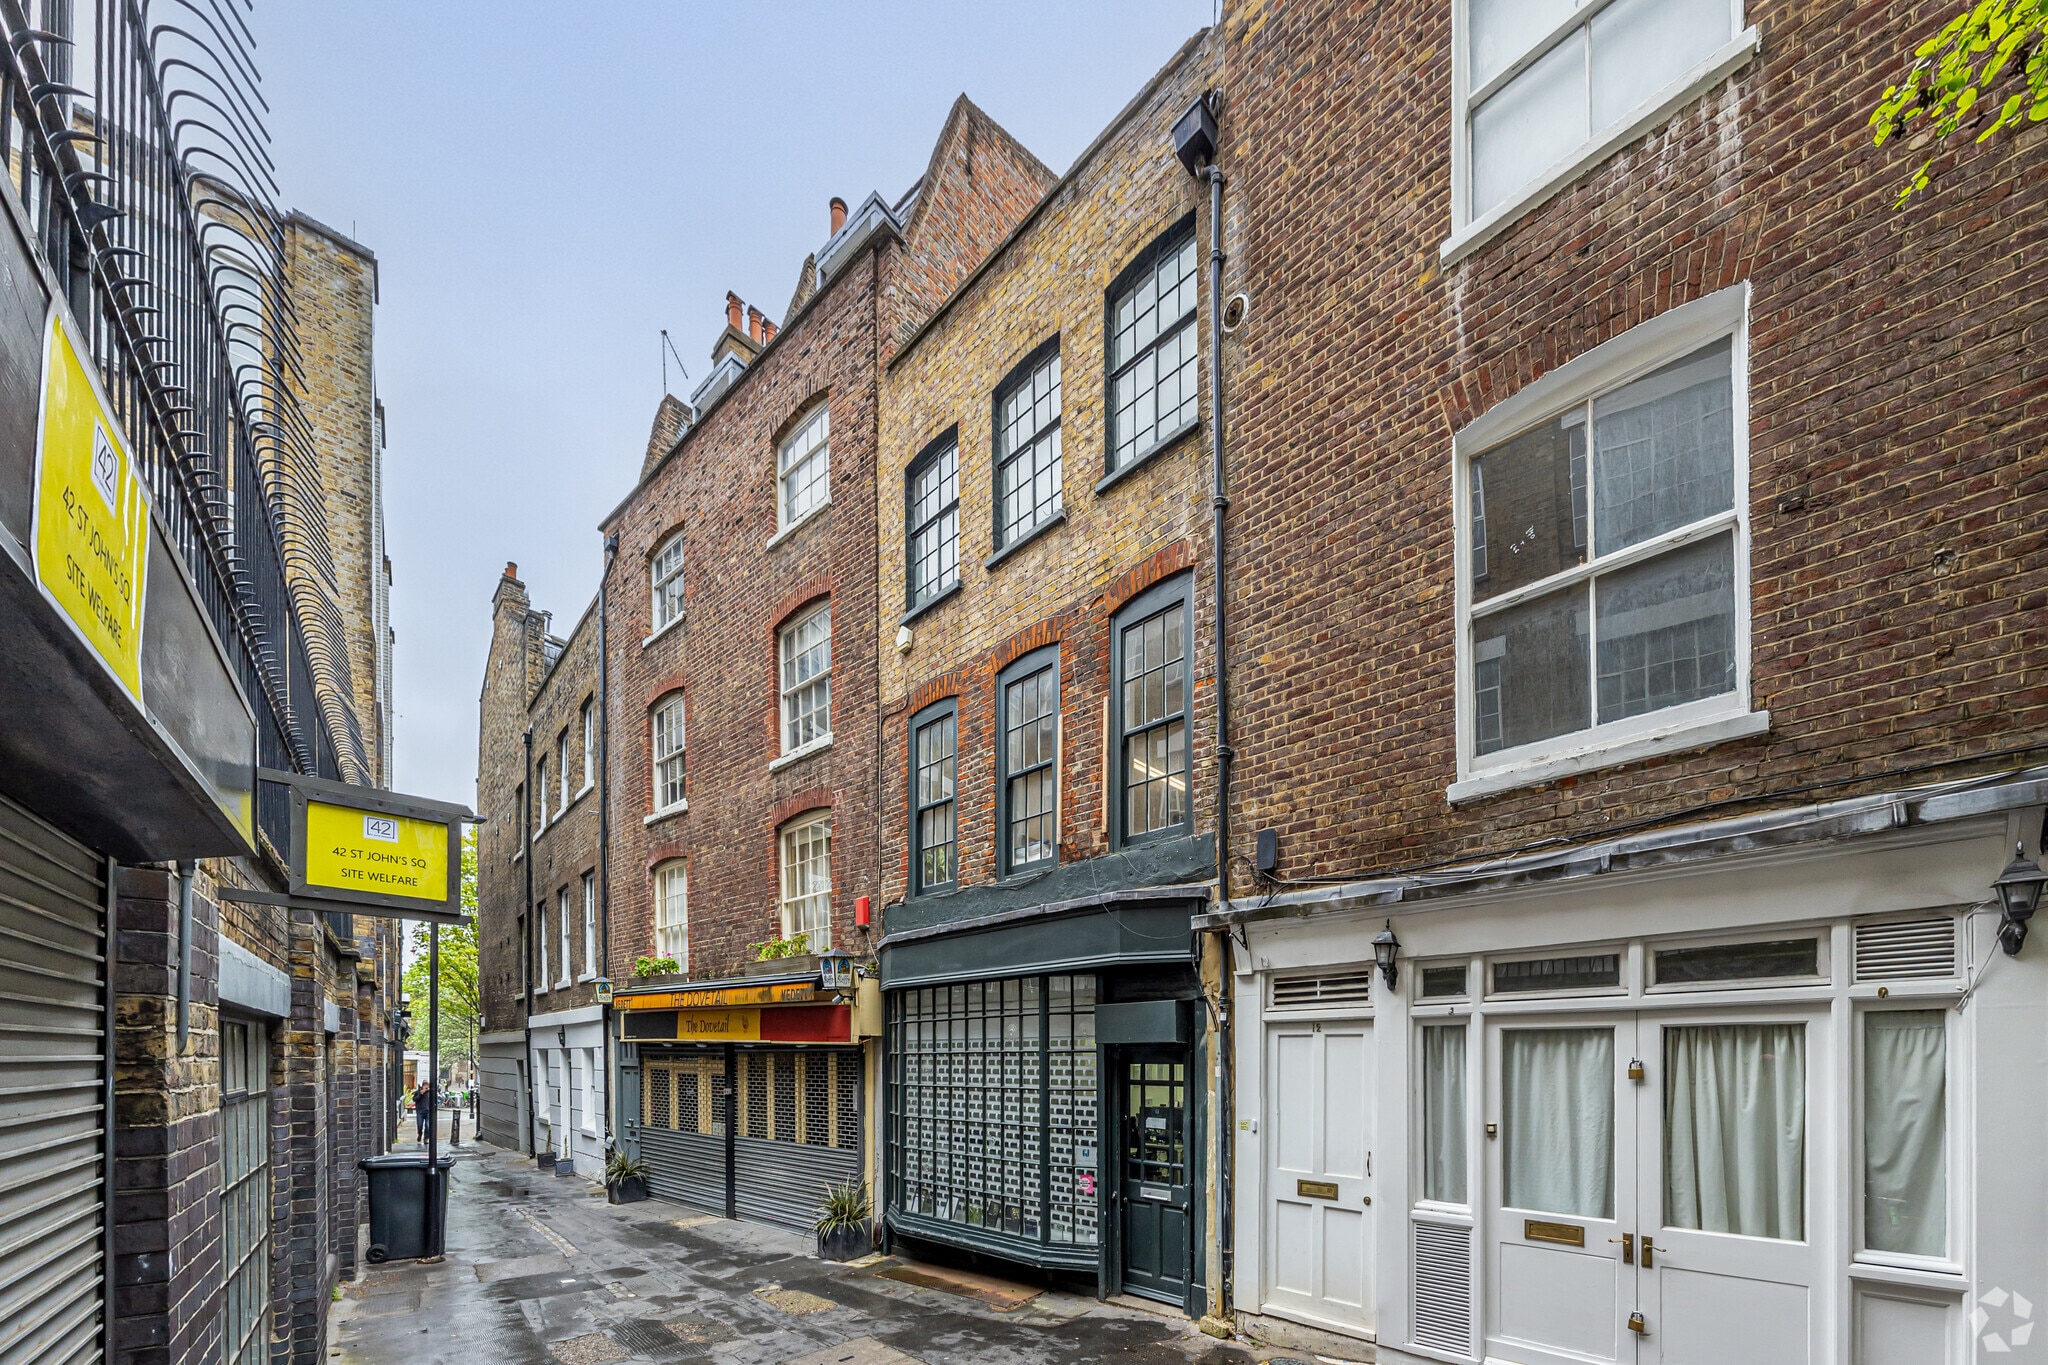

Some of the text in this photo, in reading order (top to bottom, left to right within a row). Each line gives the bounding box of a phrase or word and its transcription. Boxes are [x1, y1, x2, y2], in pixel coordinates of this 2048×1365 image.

[98, 445, 114, 492] 42
[62, 485, 131, 607] 42 ST JOHN'S SQ
[66, 554, 122, 648] SITE WELFARE
[370, 821, 391, 835] 42
[332, 847, 426, 869] 42 ST JOHN'S SQ
[341, 868, 418, 886] SITE WELFARE
[670, 990, 728, 1007] THE DOVETAIL
[686, 1014, 730, 1034] The Dovetail
[1312, 1022, 1321, 1032] 12
